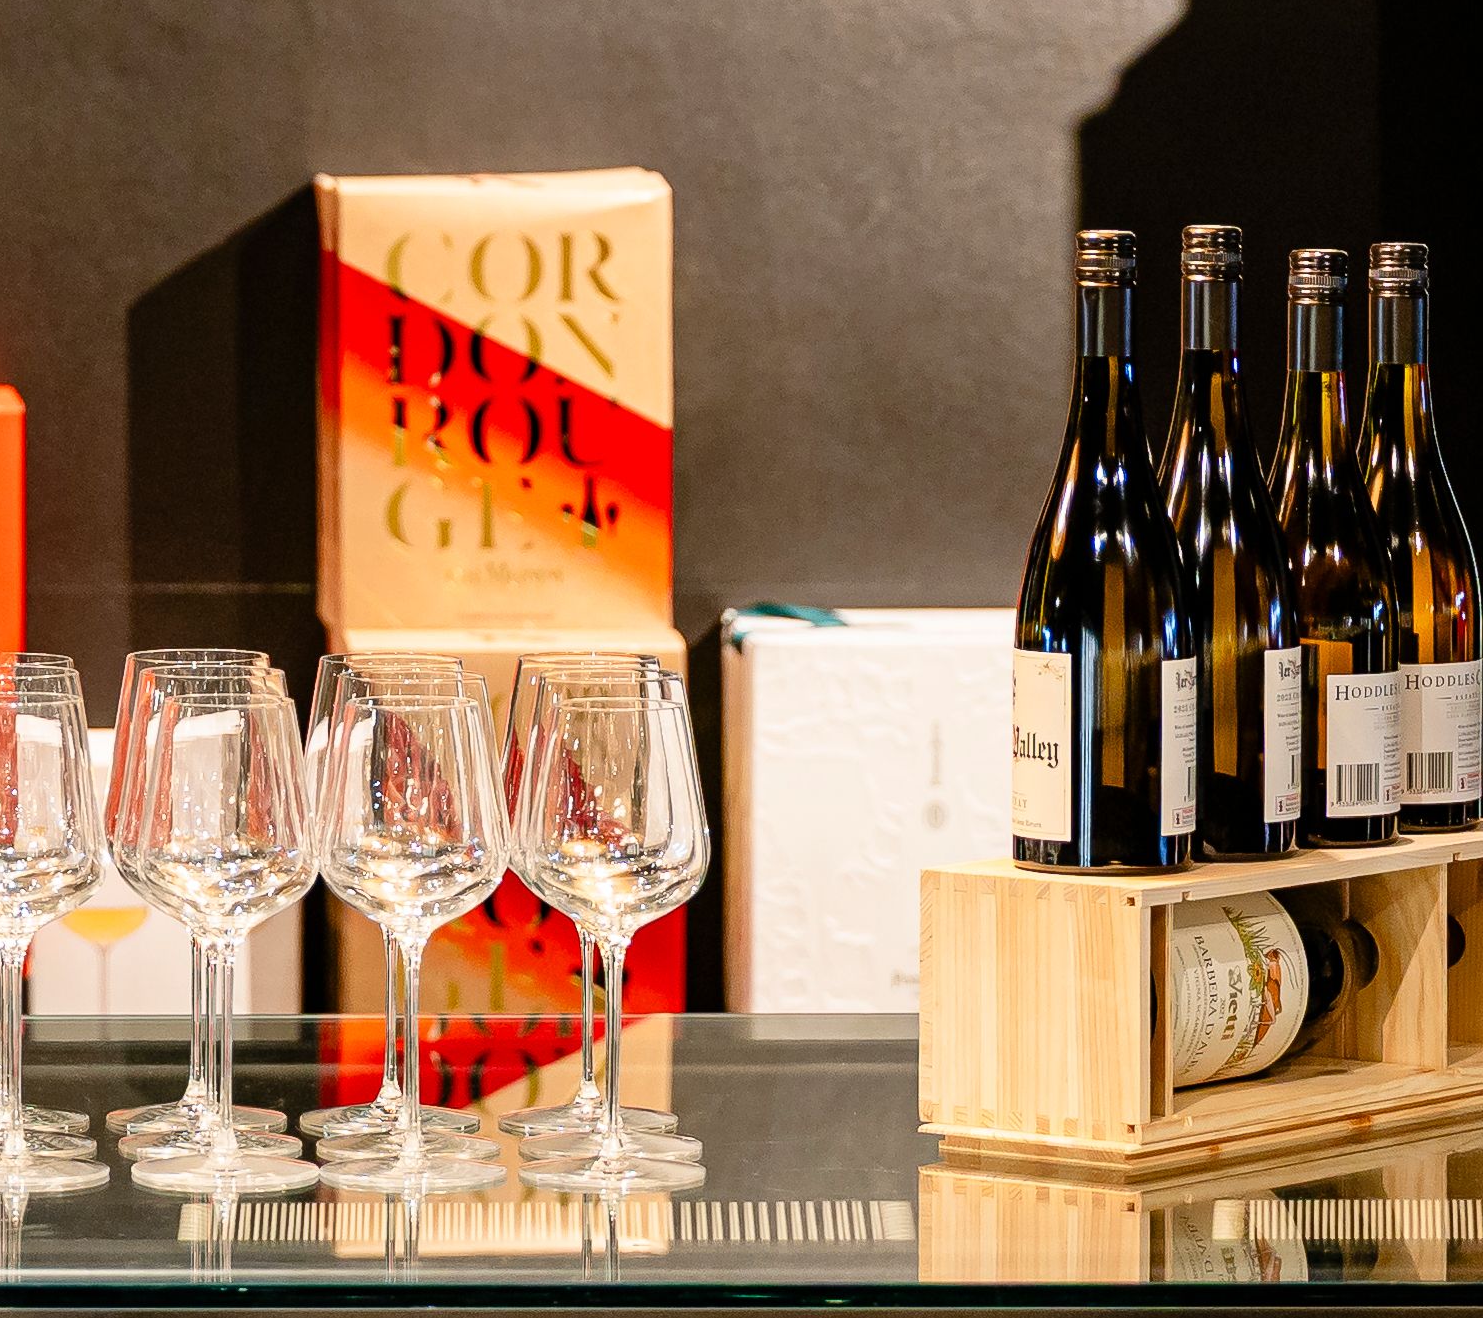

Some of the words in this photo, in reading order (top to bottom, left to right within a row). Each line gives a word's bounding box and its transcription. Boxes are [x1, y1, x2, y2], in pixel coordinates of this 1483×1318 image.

[1405, 673, 1475, 690] HODDLES
[1194, 934, 1219, 1018] BARBERA
[1220, 964, 1244, 1042] Vietti
